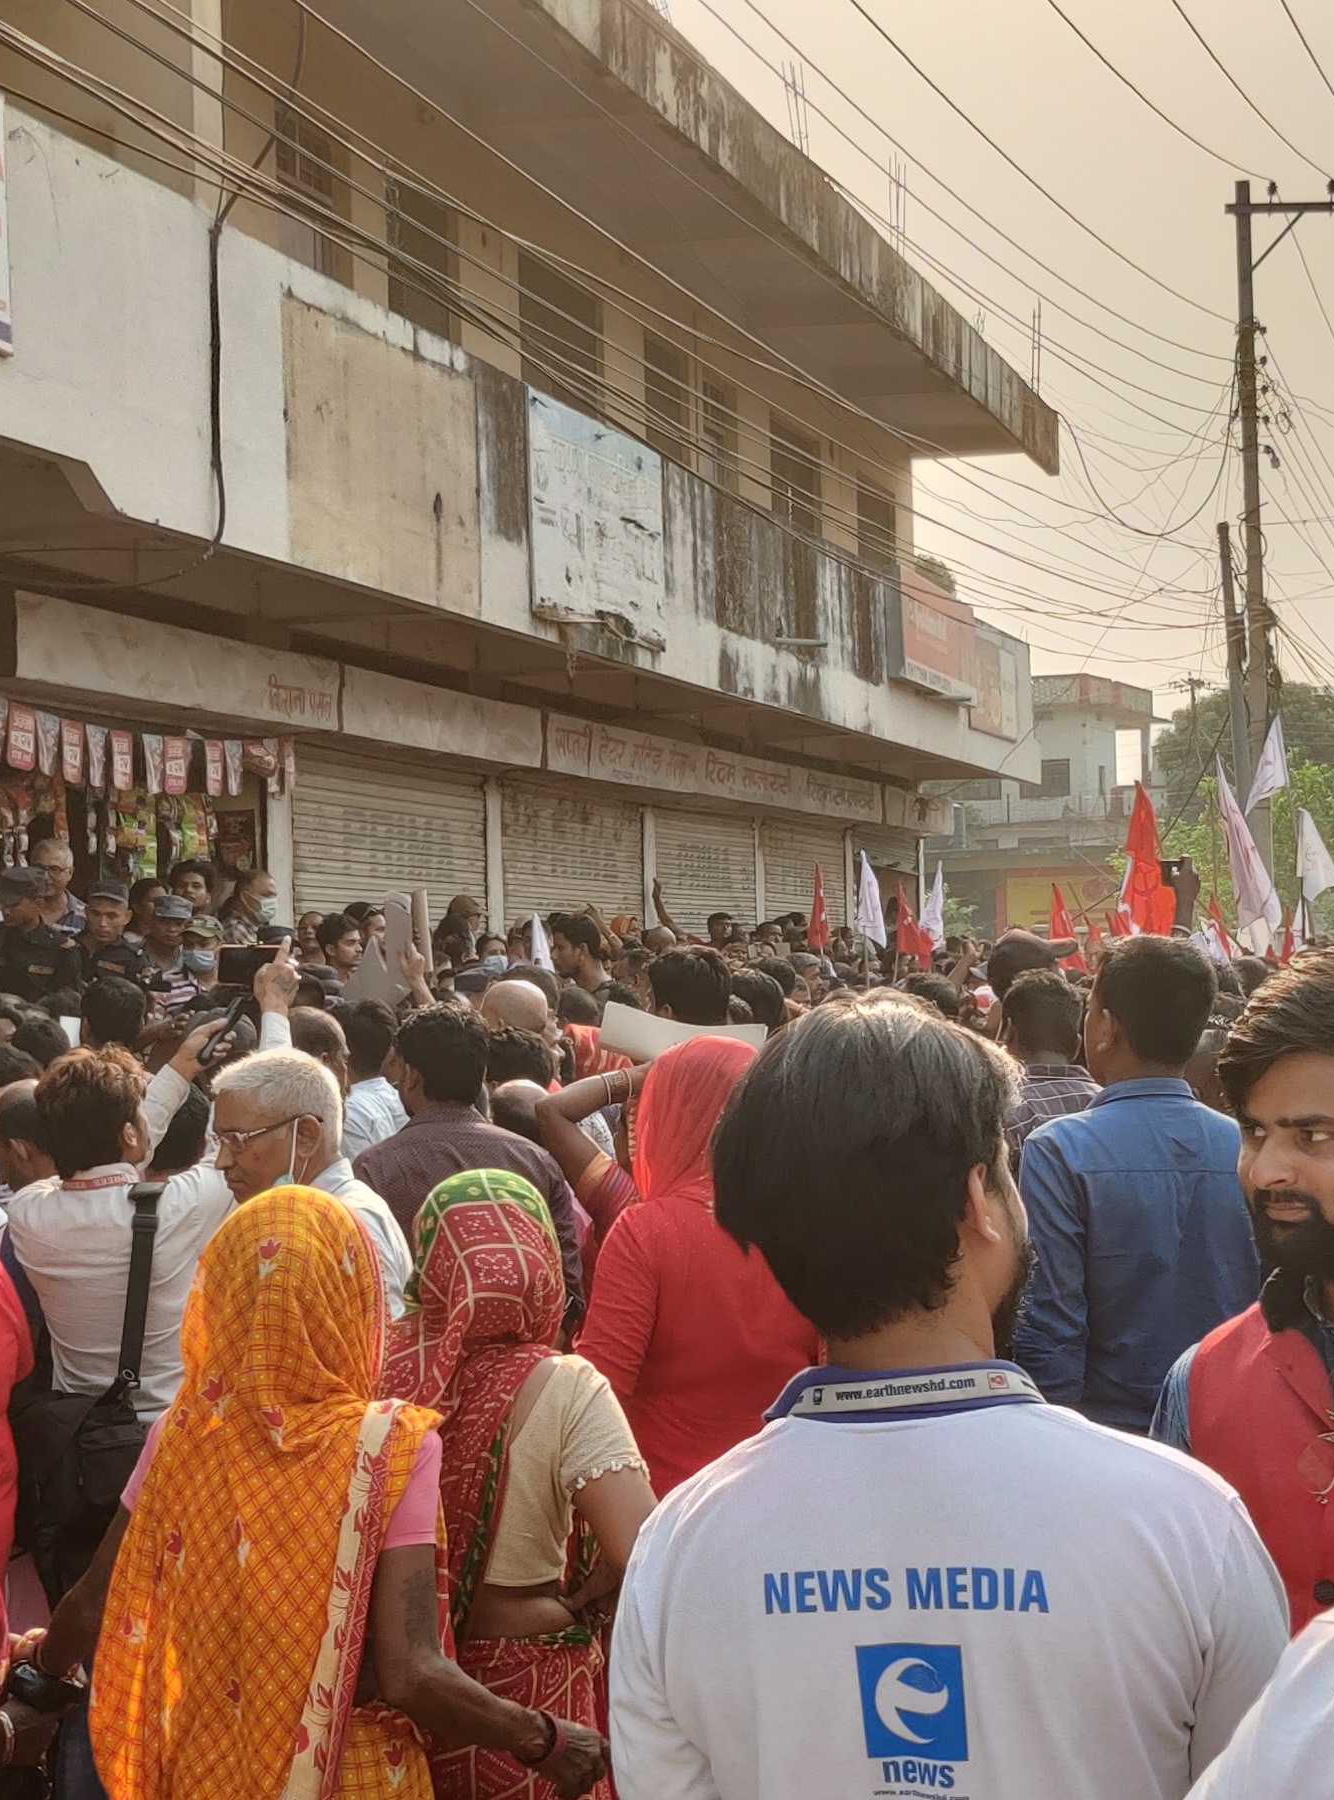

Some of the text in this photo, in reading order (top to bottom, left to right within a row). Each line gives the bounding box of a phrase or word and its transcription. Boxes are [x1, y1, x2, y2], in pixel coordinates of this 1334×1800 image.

[834, 1376, 976, 1402] www.earthnewshd.com
[763, 1567, 1050, 1615] NEWS MEDIA
[882, 1759, 955, 1789] news
